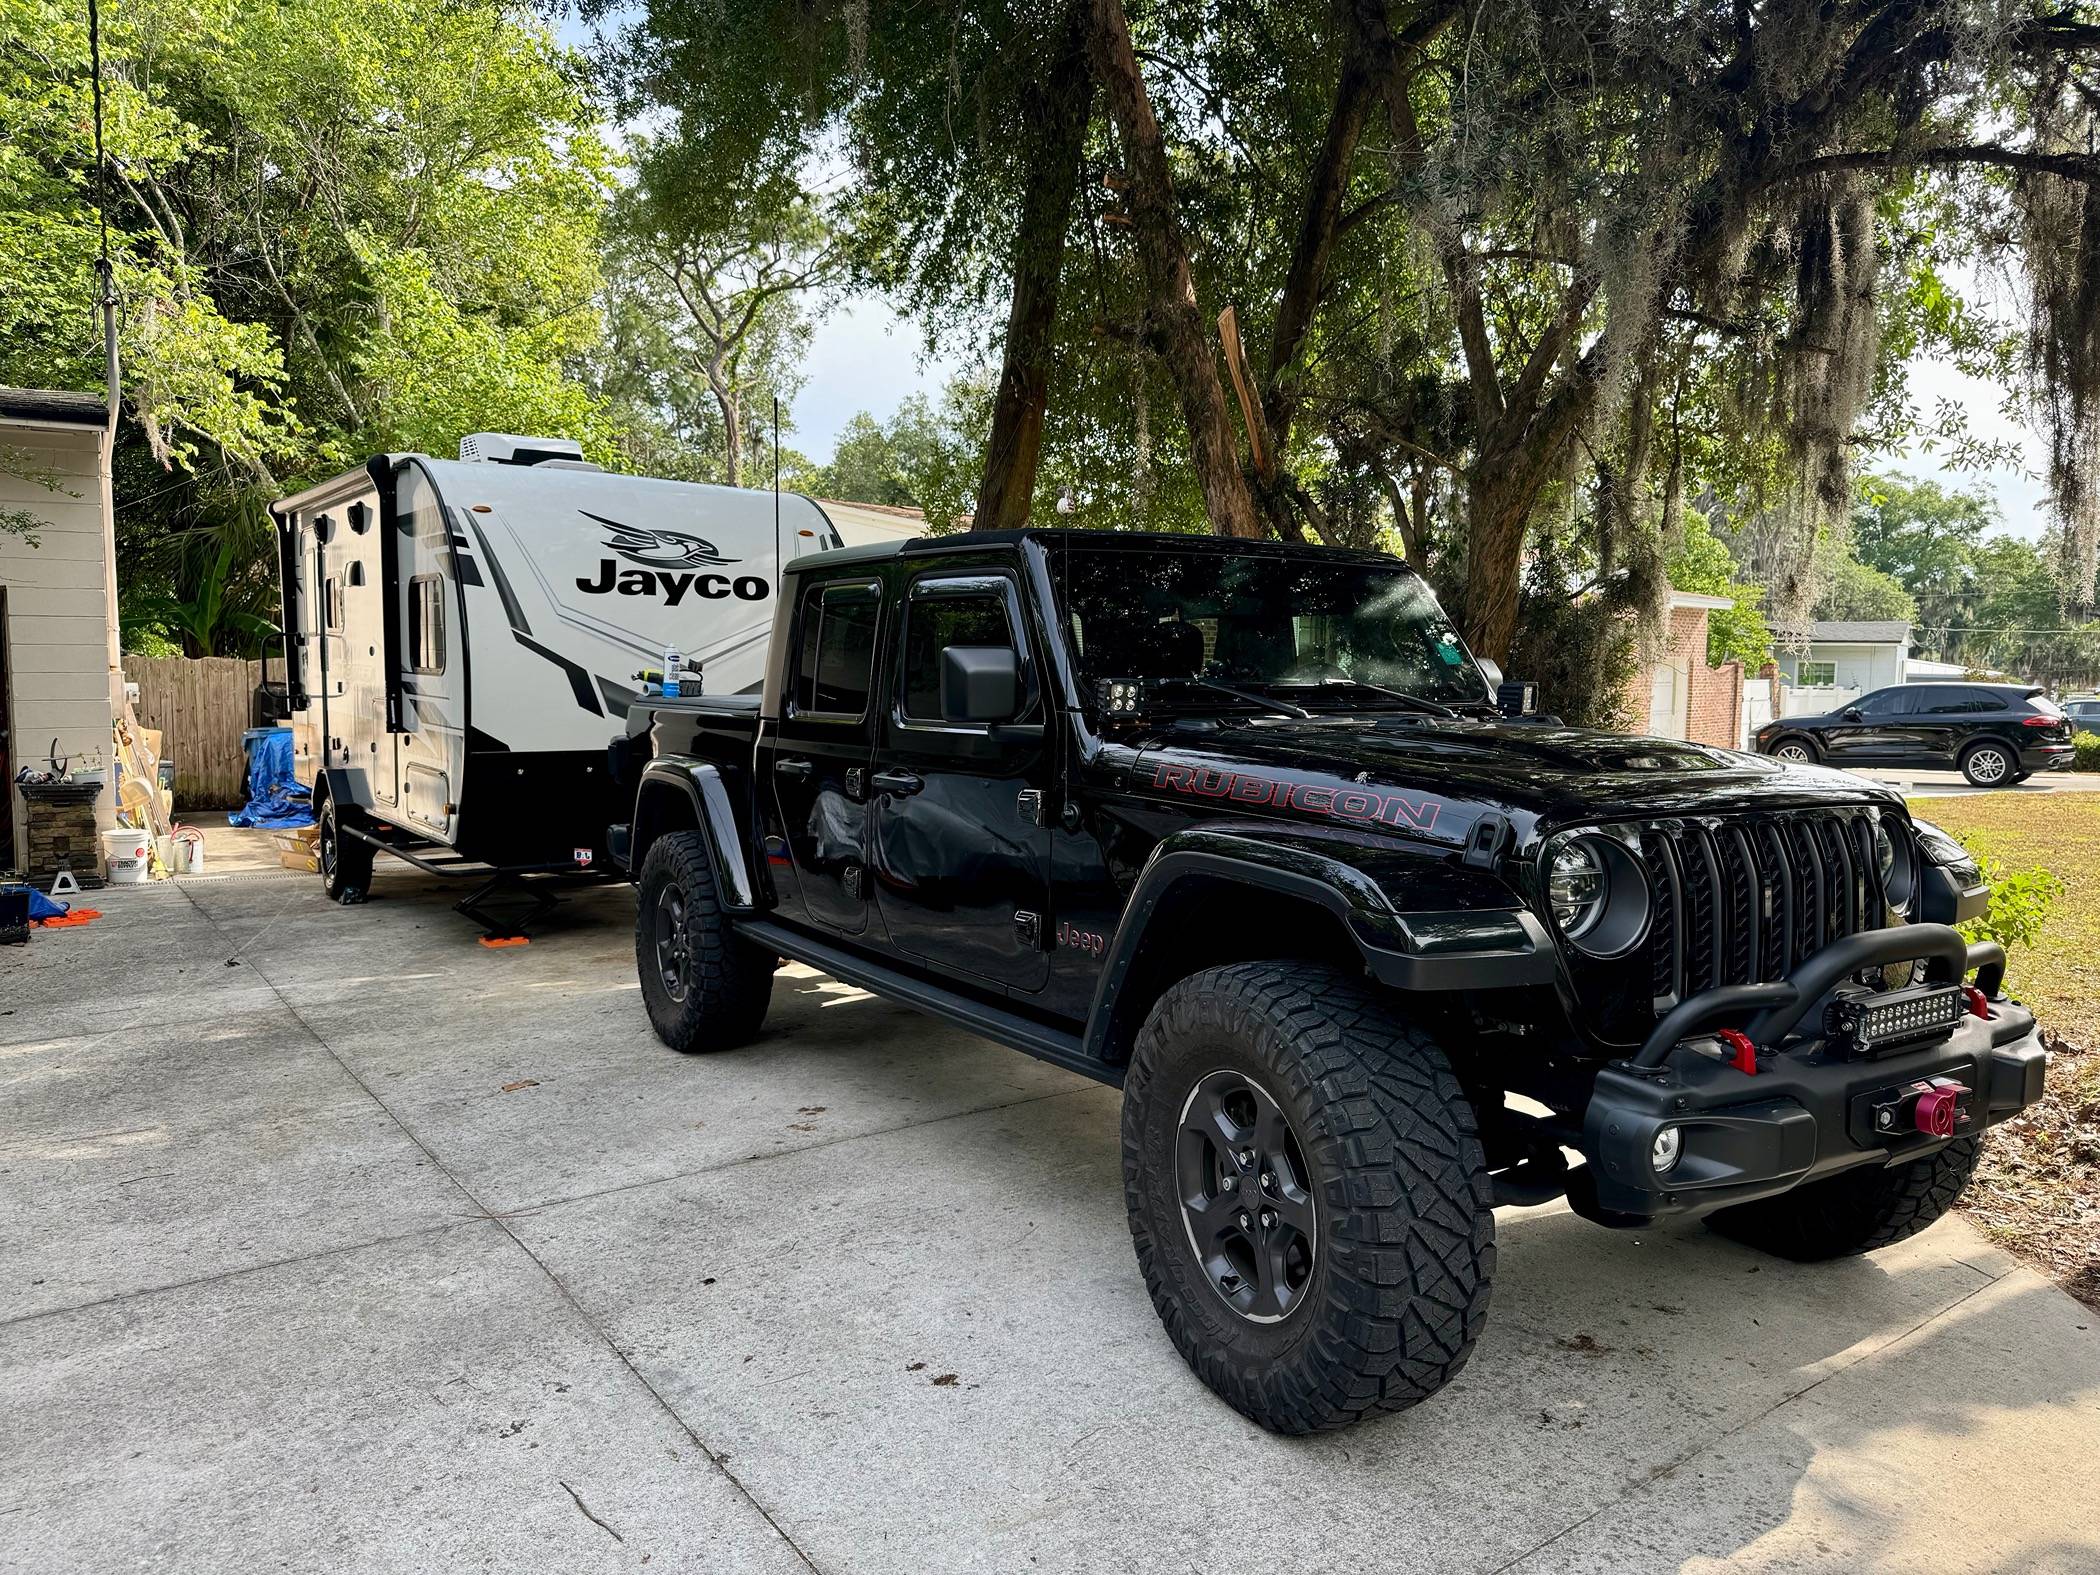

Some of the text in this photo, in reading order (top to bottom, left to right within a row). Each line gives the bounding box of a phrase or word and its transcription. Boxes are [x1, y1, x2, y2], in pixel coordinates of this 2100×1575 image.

[576, 559, 770, 606] Jayco
[1153, 764, 1441, 831] RUBICON
[1057, 921, 1104, 958] Jeep
